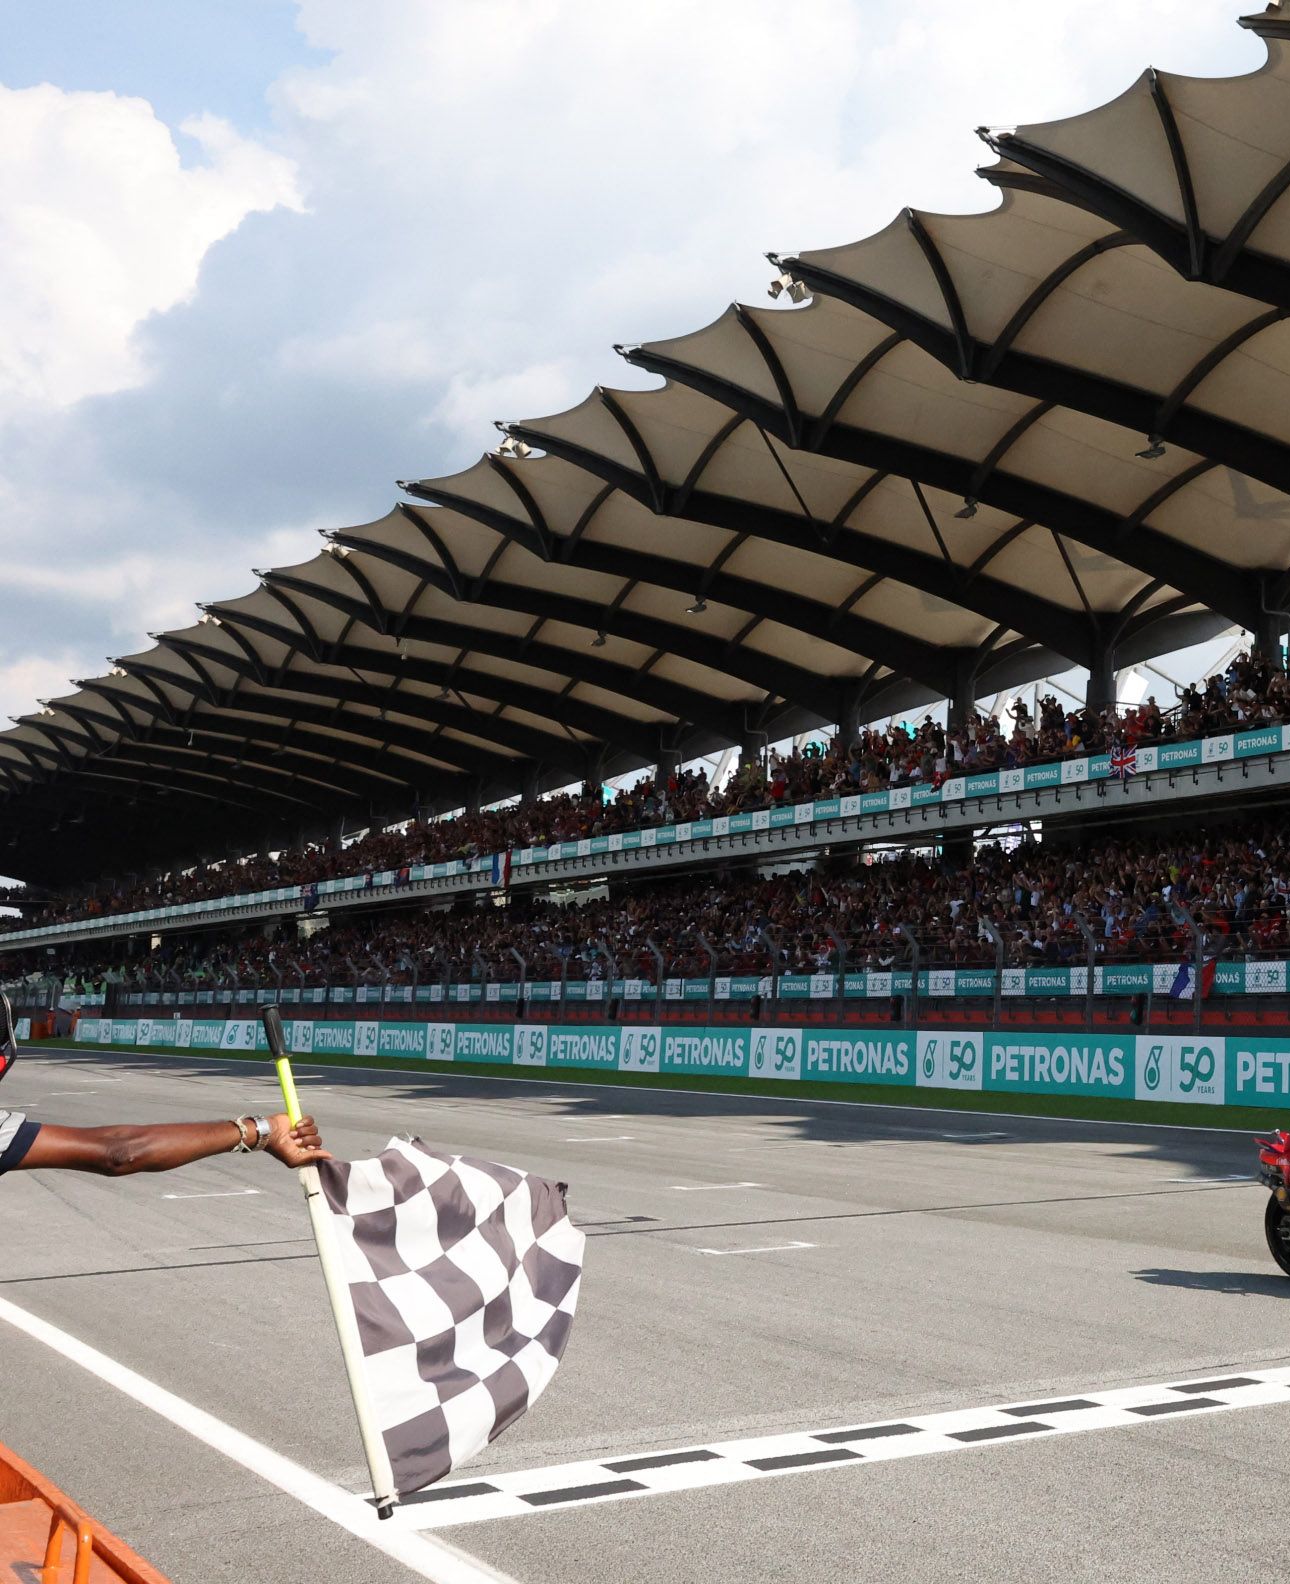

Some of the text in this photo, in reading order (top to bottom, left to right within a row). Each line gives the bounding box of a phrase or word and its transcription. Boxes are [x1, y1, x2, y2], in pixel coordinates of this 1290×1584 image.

[1219, 741, 1228, 754] 50
[1238, 735, 1277, 750] PETRONAS
[1161, 749, 1197, 761] PETRONAS
[968, 780, 996, 790] PETRONAS
[1027, 770, 1057, 782] PETRONAS
[958, 978, 992, 988] PETRONAS
[1029, 976, 1067, 987] PETRONAS
[1107, 974, 1148, 986] PETRONAS
[245, 1025, 255, 1045] 50
[315, 1027, 352, 1048] PETRONAS
[366, 1027, 376, 1050] 50
[380, 1030, 424, 1051] PETRONAS
[440, 1029, 452, 1055] 50
[457, 1032, 510, 1057] PETRONAS
[530, 1031, 544, 1060] 50
[550, 1035, 615, 1061] PETRONAS
[640, 1034, 656, 1065] 50
[664, 1037, 744, 1067] PETRONAS
[775, 1037, 796, 1071] 50
[807, 1040, 908, 1075] PETRONAS
[949, 1041, 976, 1080] 50
[991, 1046, 1125, 1085] PETRONAS
[1180, 1047, 1215, 1093] 50
[1197, 1086, 1215, 1094] YEARS
